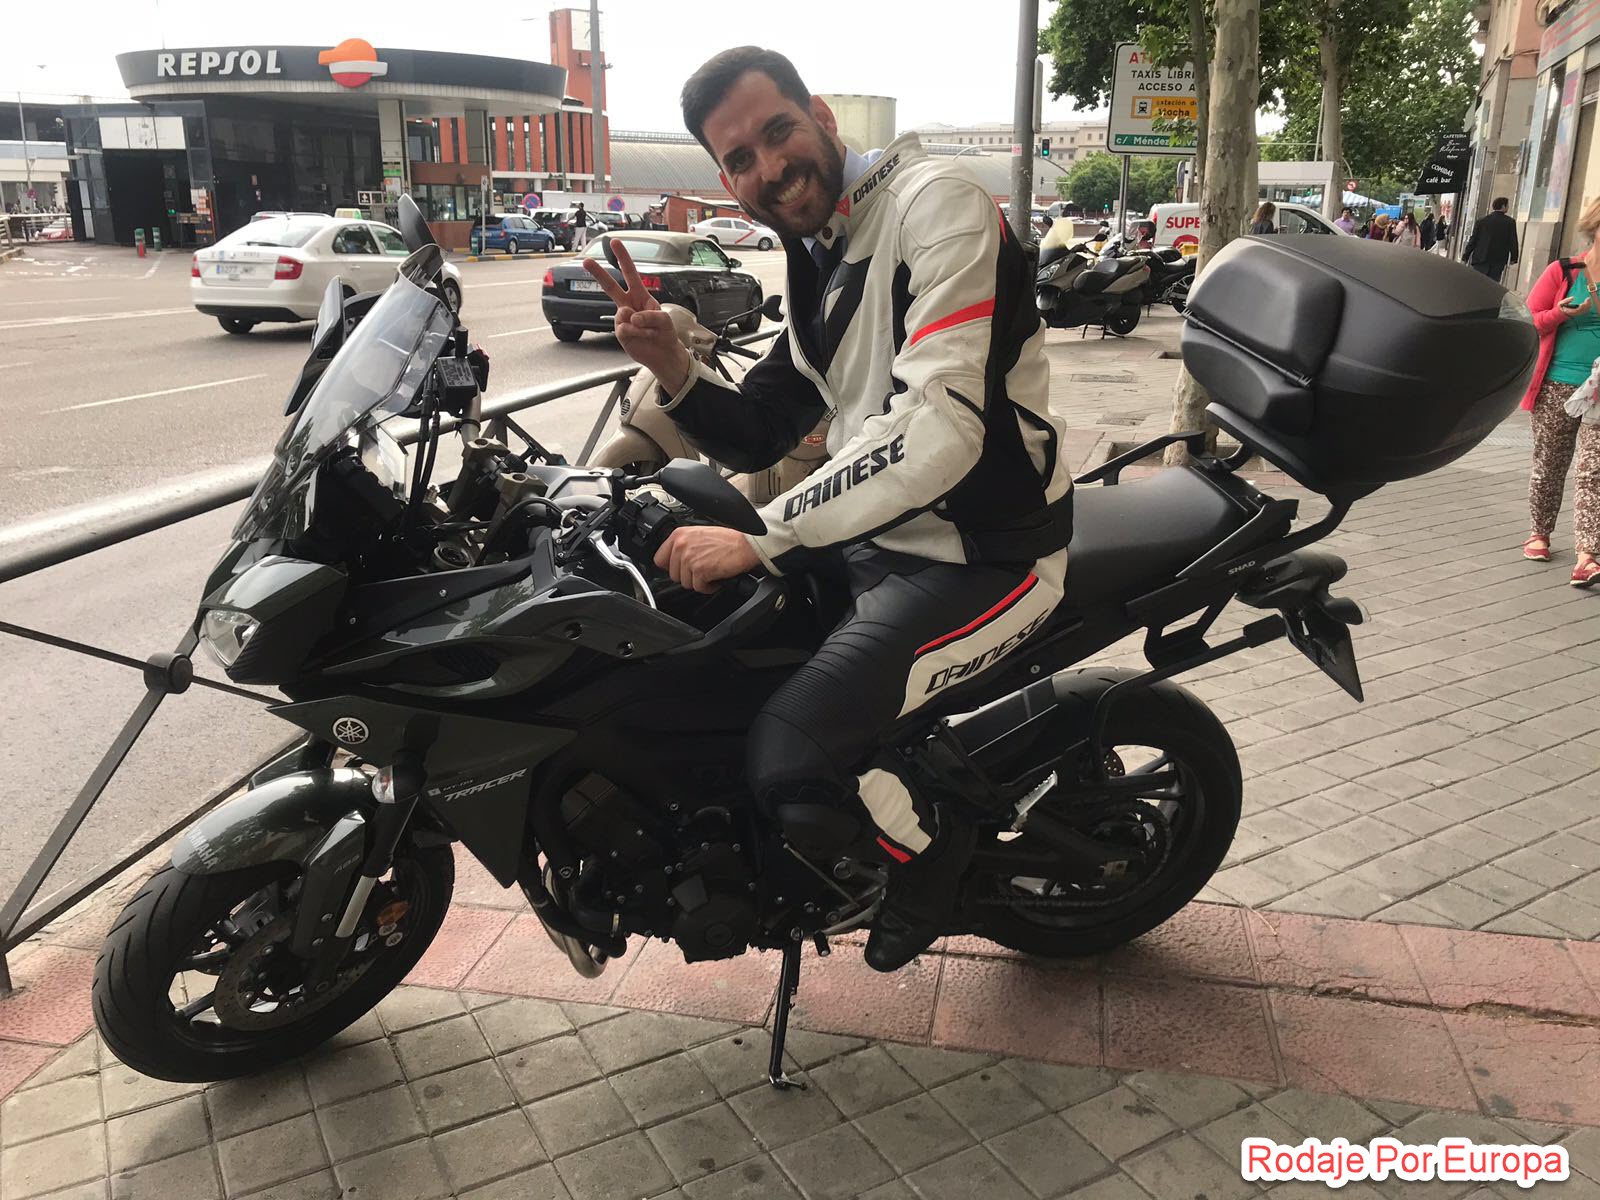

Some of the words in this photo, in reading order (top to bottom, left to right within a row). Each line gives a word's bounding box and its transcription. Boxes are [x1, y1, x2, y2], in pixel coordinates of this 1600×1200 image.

[157, 49, 281, 77] REPSOL
[1131, 70, 1161, 79] TAXIS
[1138, 82, 1183, 92] ACCESO
[853, 153, 900, 205] DAINESE
[1431, 164, 1454, 177] COMIDAS
[783, 433, 905, 523] DAINESE
[1228, 560, 1256, 576] SHAD
[444, 768, 528, 802] TRACER
